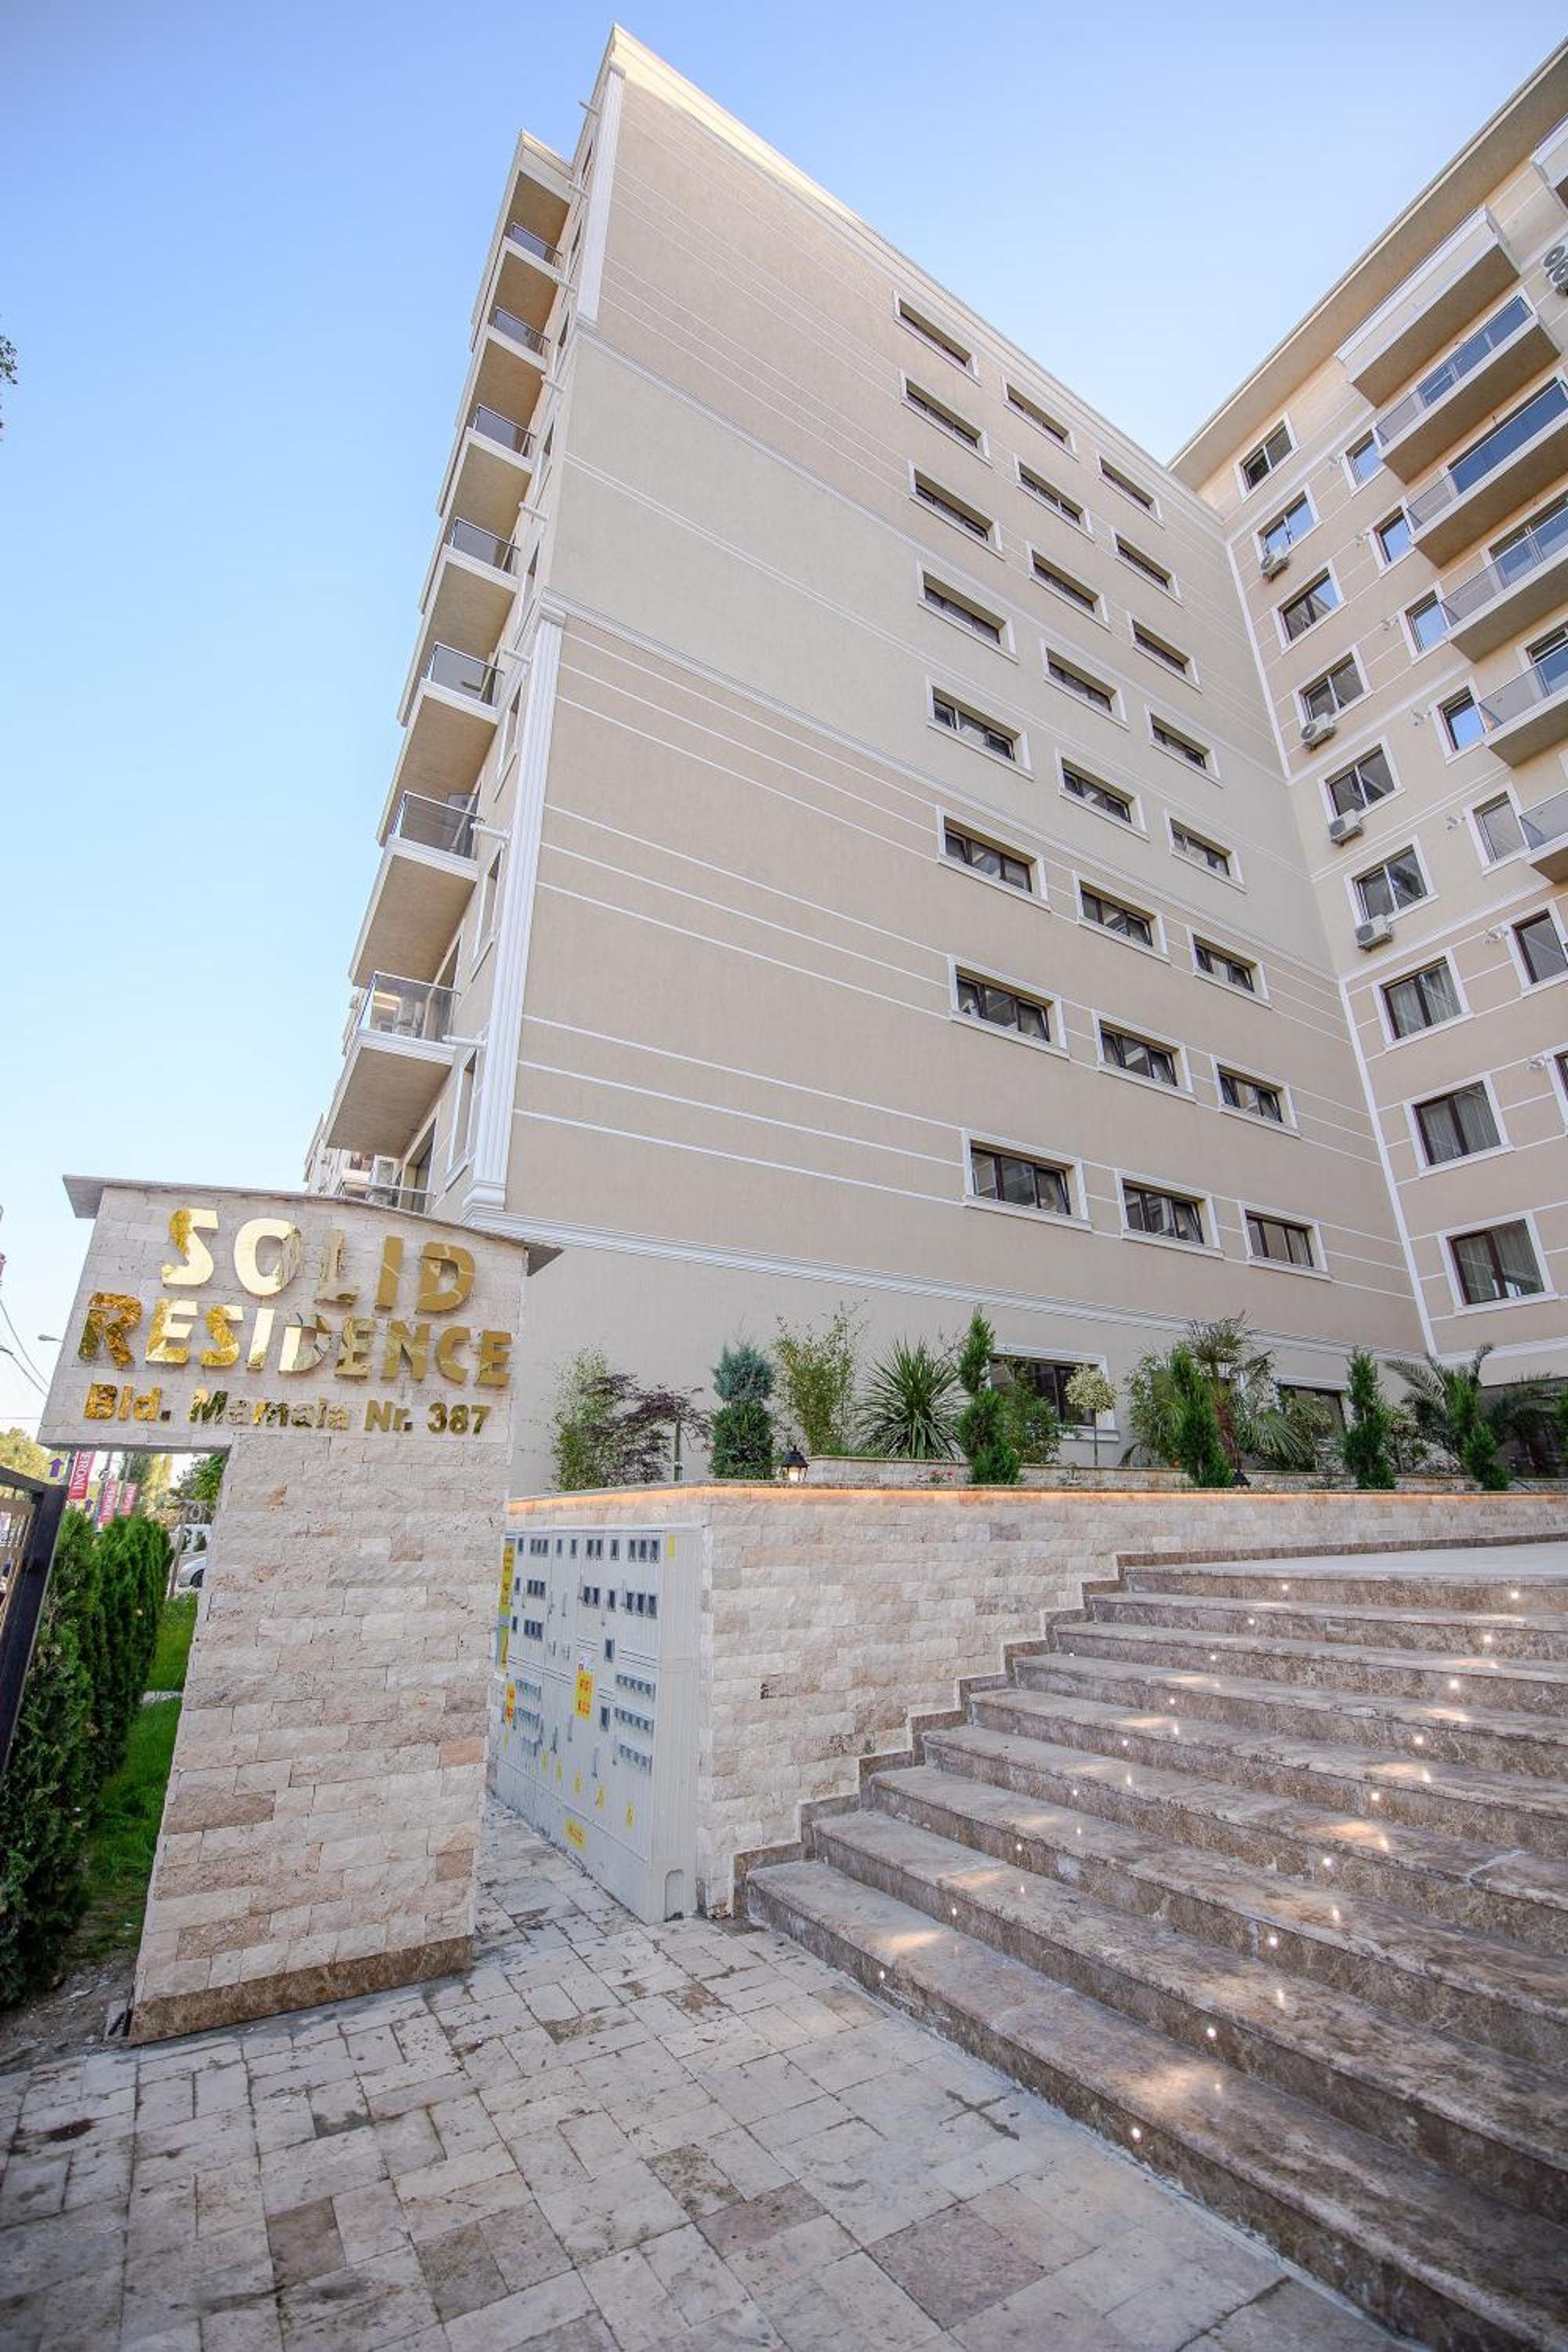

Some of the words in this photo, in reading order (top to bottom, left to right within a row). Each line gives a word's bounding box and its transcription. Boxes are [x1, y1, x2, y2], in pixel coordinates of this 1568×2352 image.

[160, 1207, 477, 1314] SOLID
[78, 1291, 514, 1388] RESIDENCE
[83, 1381, 172, 1421] Bld.
[188, 1388, 350, 1432] Mamaia
[363, 1399, 413, 1432] Nr.
[427, 1402, 492, 1436] 387
[72, 1451, 90, 1489] ERONI
